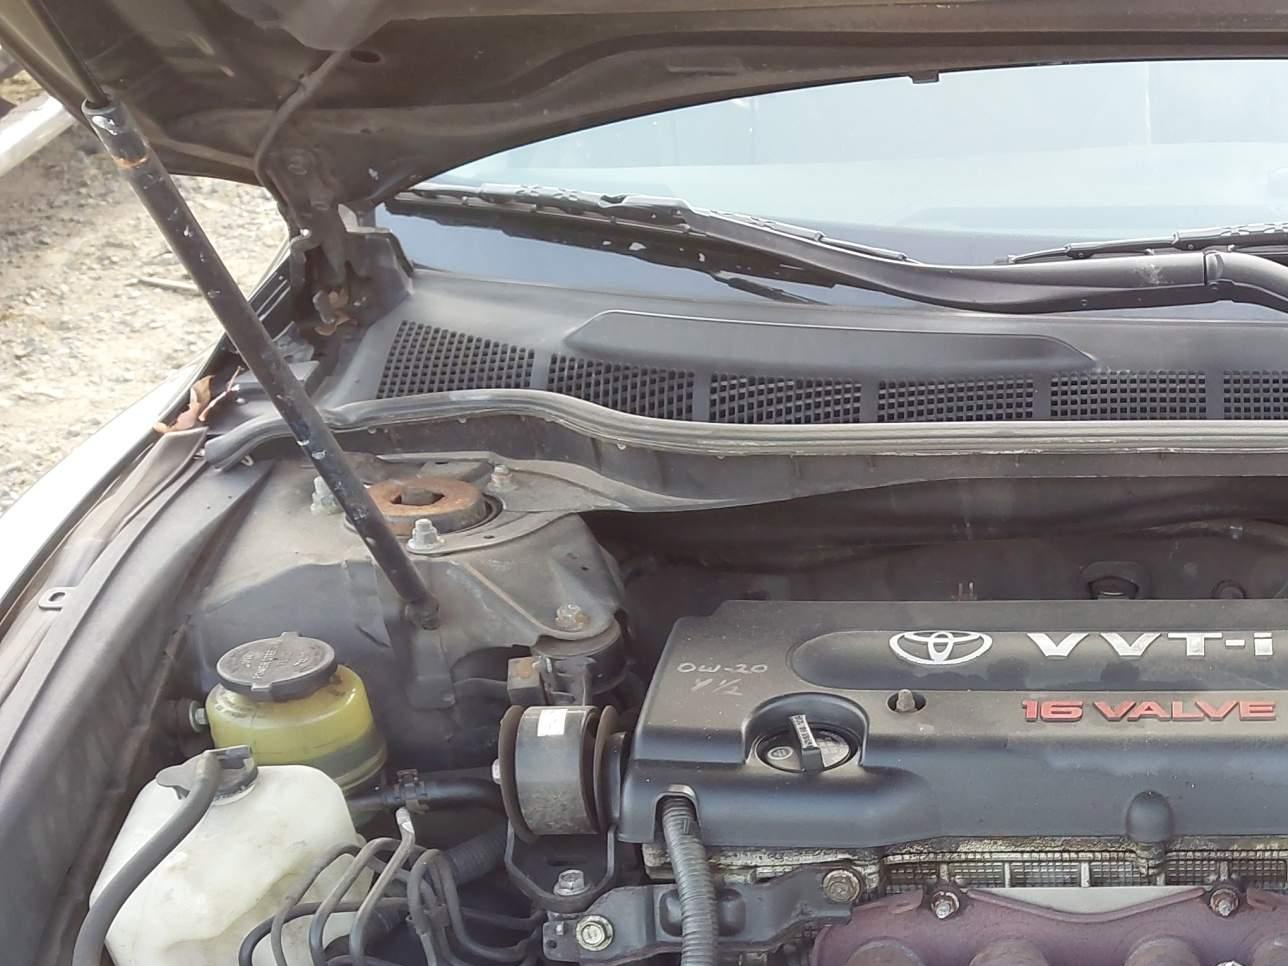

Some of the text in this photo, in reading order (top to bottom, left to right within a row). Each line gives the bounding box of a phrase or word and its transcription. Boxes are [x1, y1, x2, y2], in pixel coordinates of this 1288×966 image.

[1026, 632, 1274, 657] VVT-i
[1022, 700, 1277, 722] 16 VALVE
